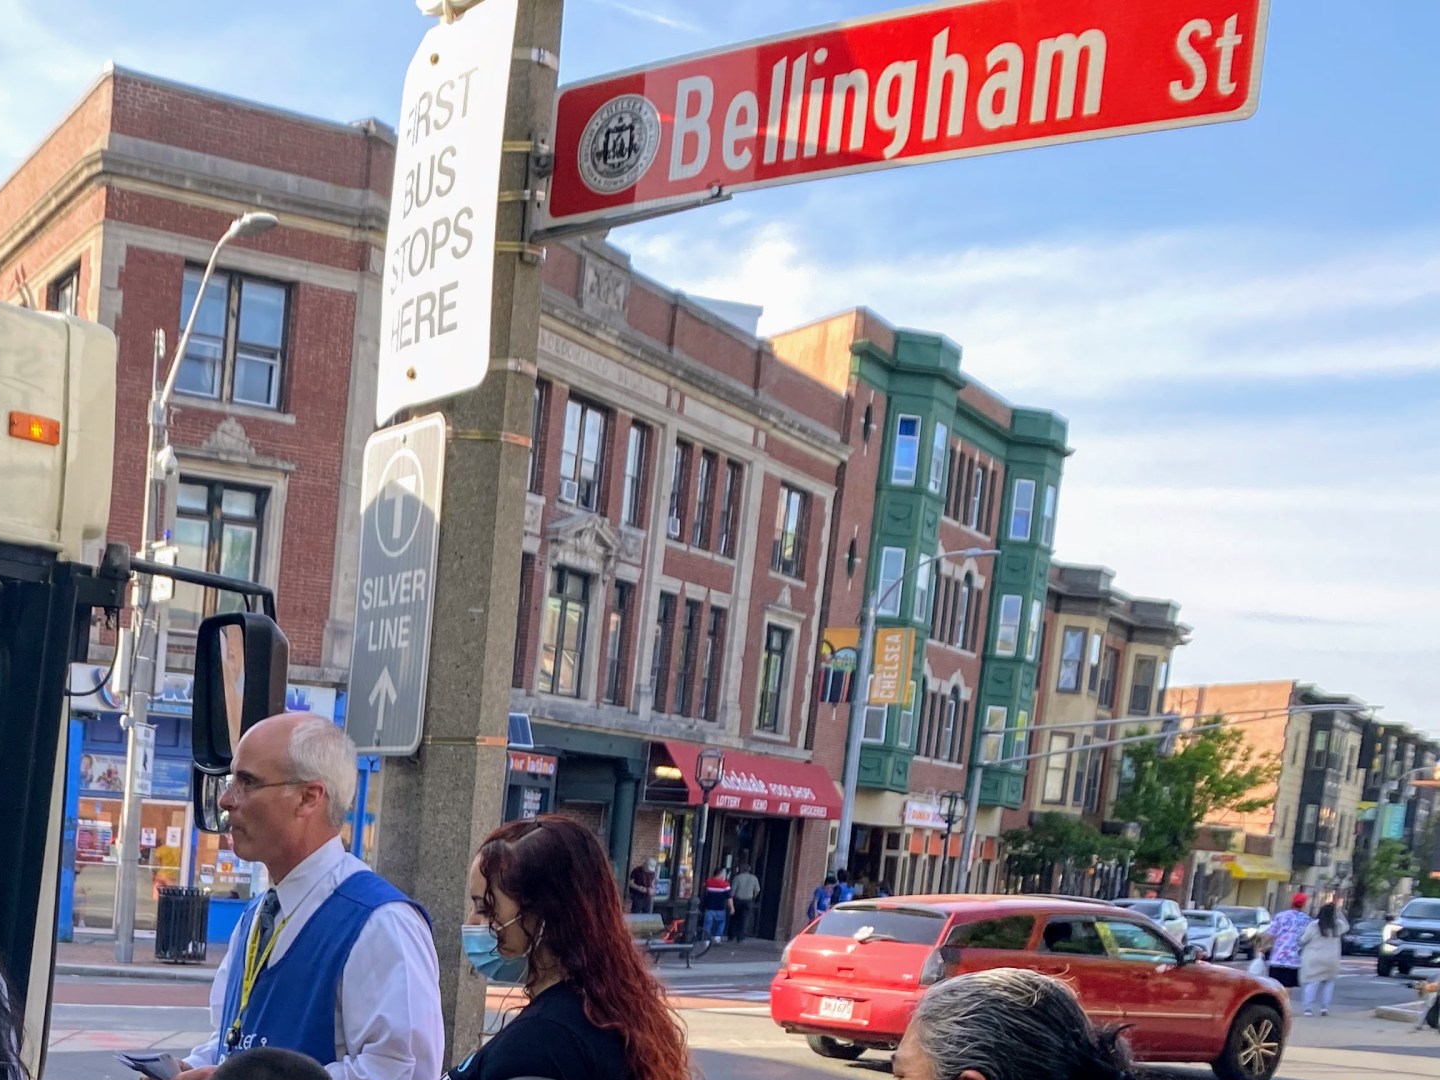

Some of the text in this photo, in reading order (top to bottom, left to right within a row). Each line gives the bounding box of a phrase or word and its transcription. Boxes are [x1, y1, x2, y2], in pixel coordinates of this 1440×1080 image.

[668, 26, 1107, 182] Bellingham
[1169, 13, 1244, 102] St
[403, 145, 457, 219] BUS
[391, 206, 474, 295] STOPS
[391, 280, 459, 354] HERE
[362, 568, 427, 610] SILVER
[367, 614, 412, 652] LINE
[880, 633, 902, 699] CHELSEA
[527, 756, 555, 775] latino
[716, 795, 741, 808] LOTTERY
[752, 799, 768, 811] KENO
